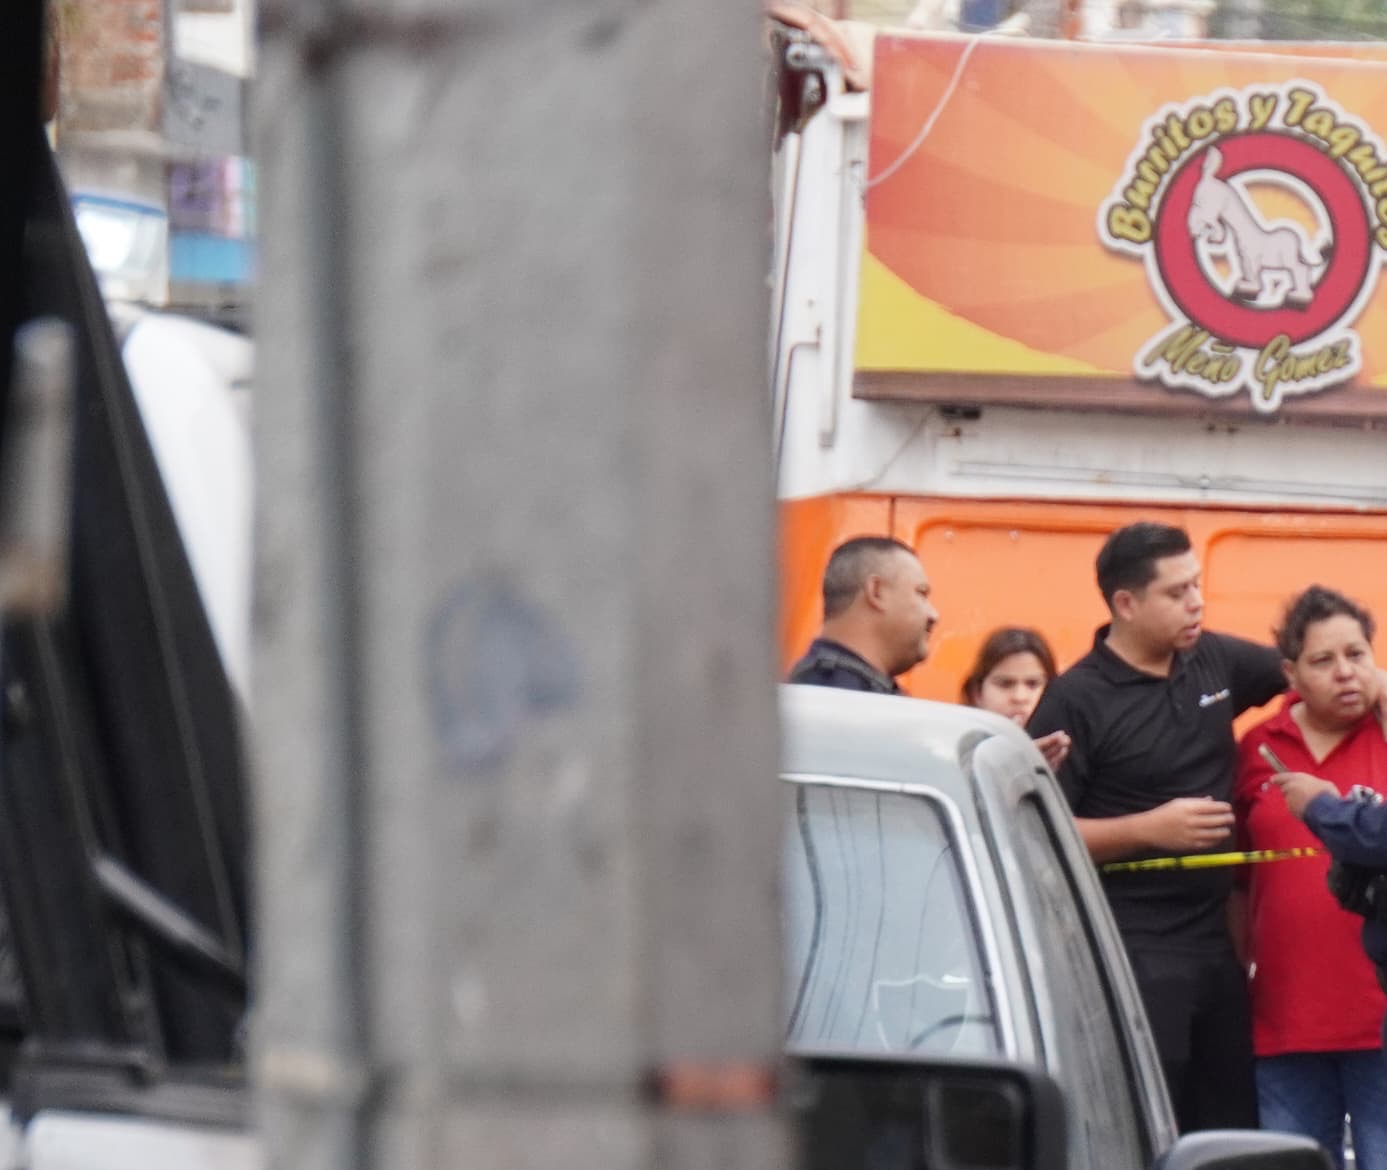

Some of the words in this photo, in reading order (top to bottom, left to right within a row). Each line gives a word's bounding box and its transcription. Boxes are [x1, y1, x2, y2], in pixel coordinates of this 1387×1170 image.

[1107, 96, 1238, 244] Burritos
[1248, 93, 1279, 130] y
[1254, 334, 1352, 400] Gomez
